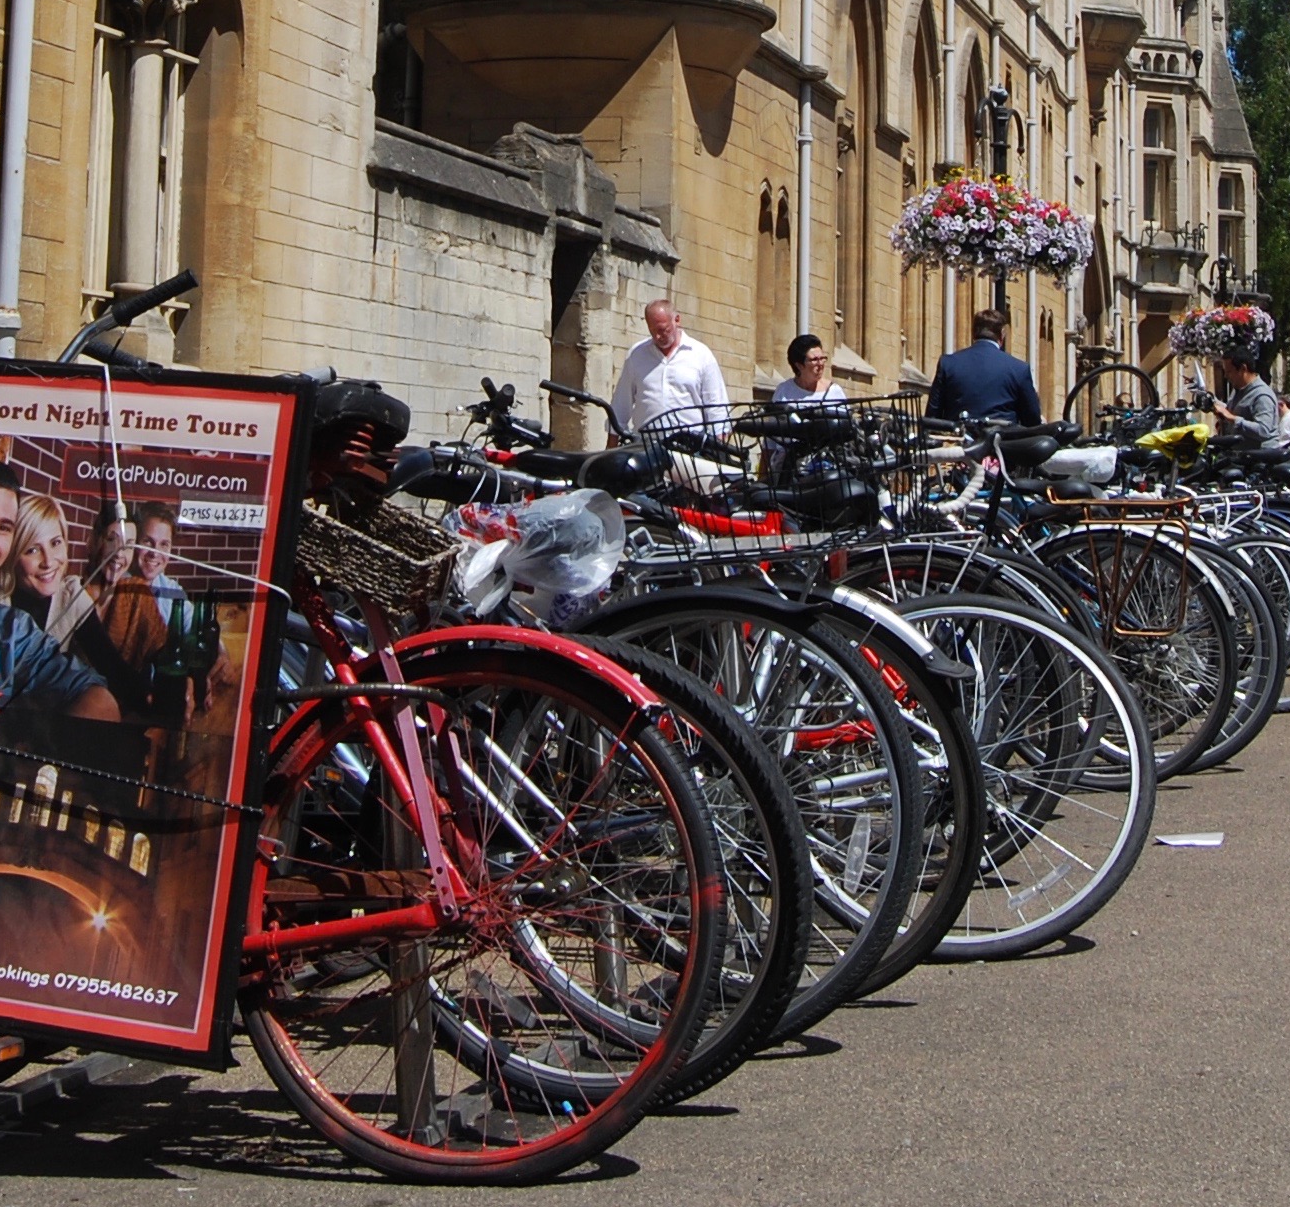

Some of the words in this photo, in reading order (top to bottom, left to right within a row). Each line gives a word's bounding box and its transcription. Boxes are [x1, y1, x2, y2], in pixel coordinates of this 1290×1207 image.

[45, 404, 110, 429] Night
[120, 409, 178, 432] Time
[187, 414, 259, 438] Tours
[76, 460, 248, 492] OxfordPubTour.com
[53, 972, 179, 1007] 07955482637
